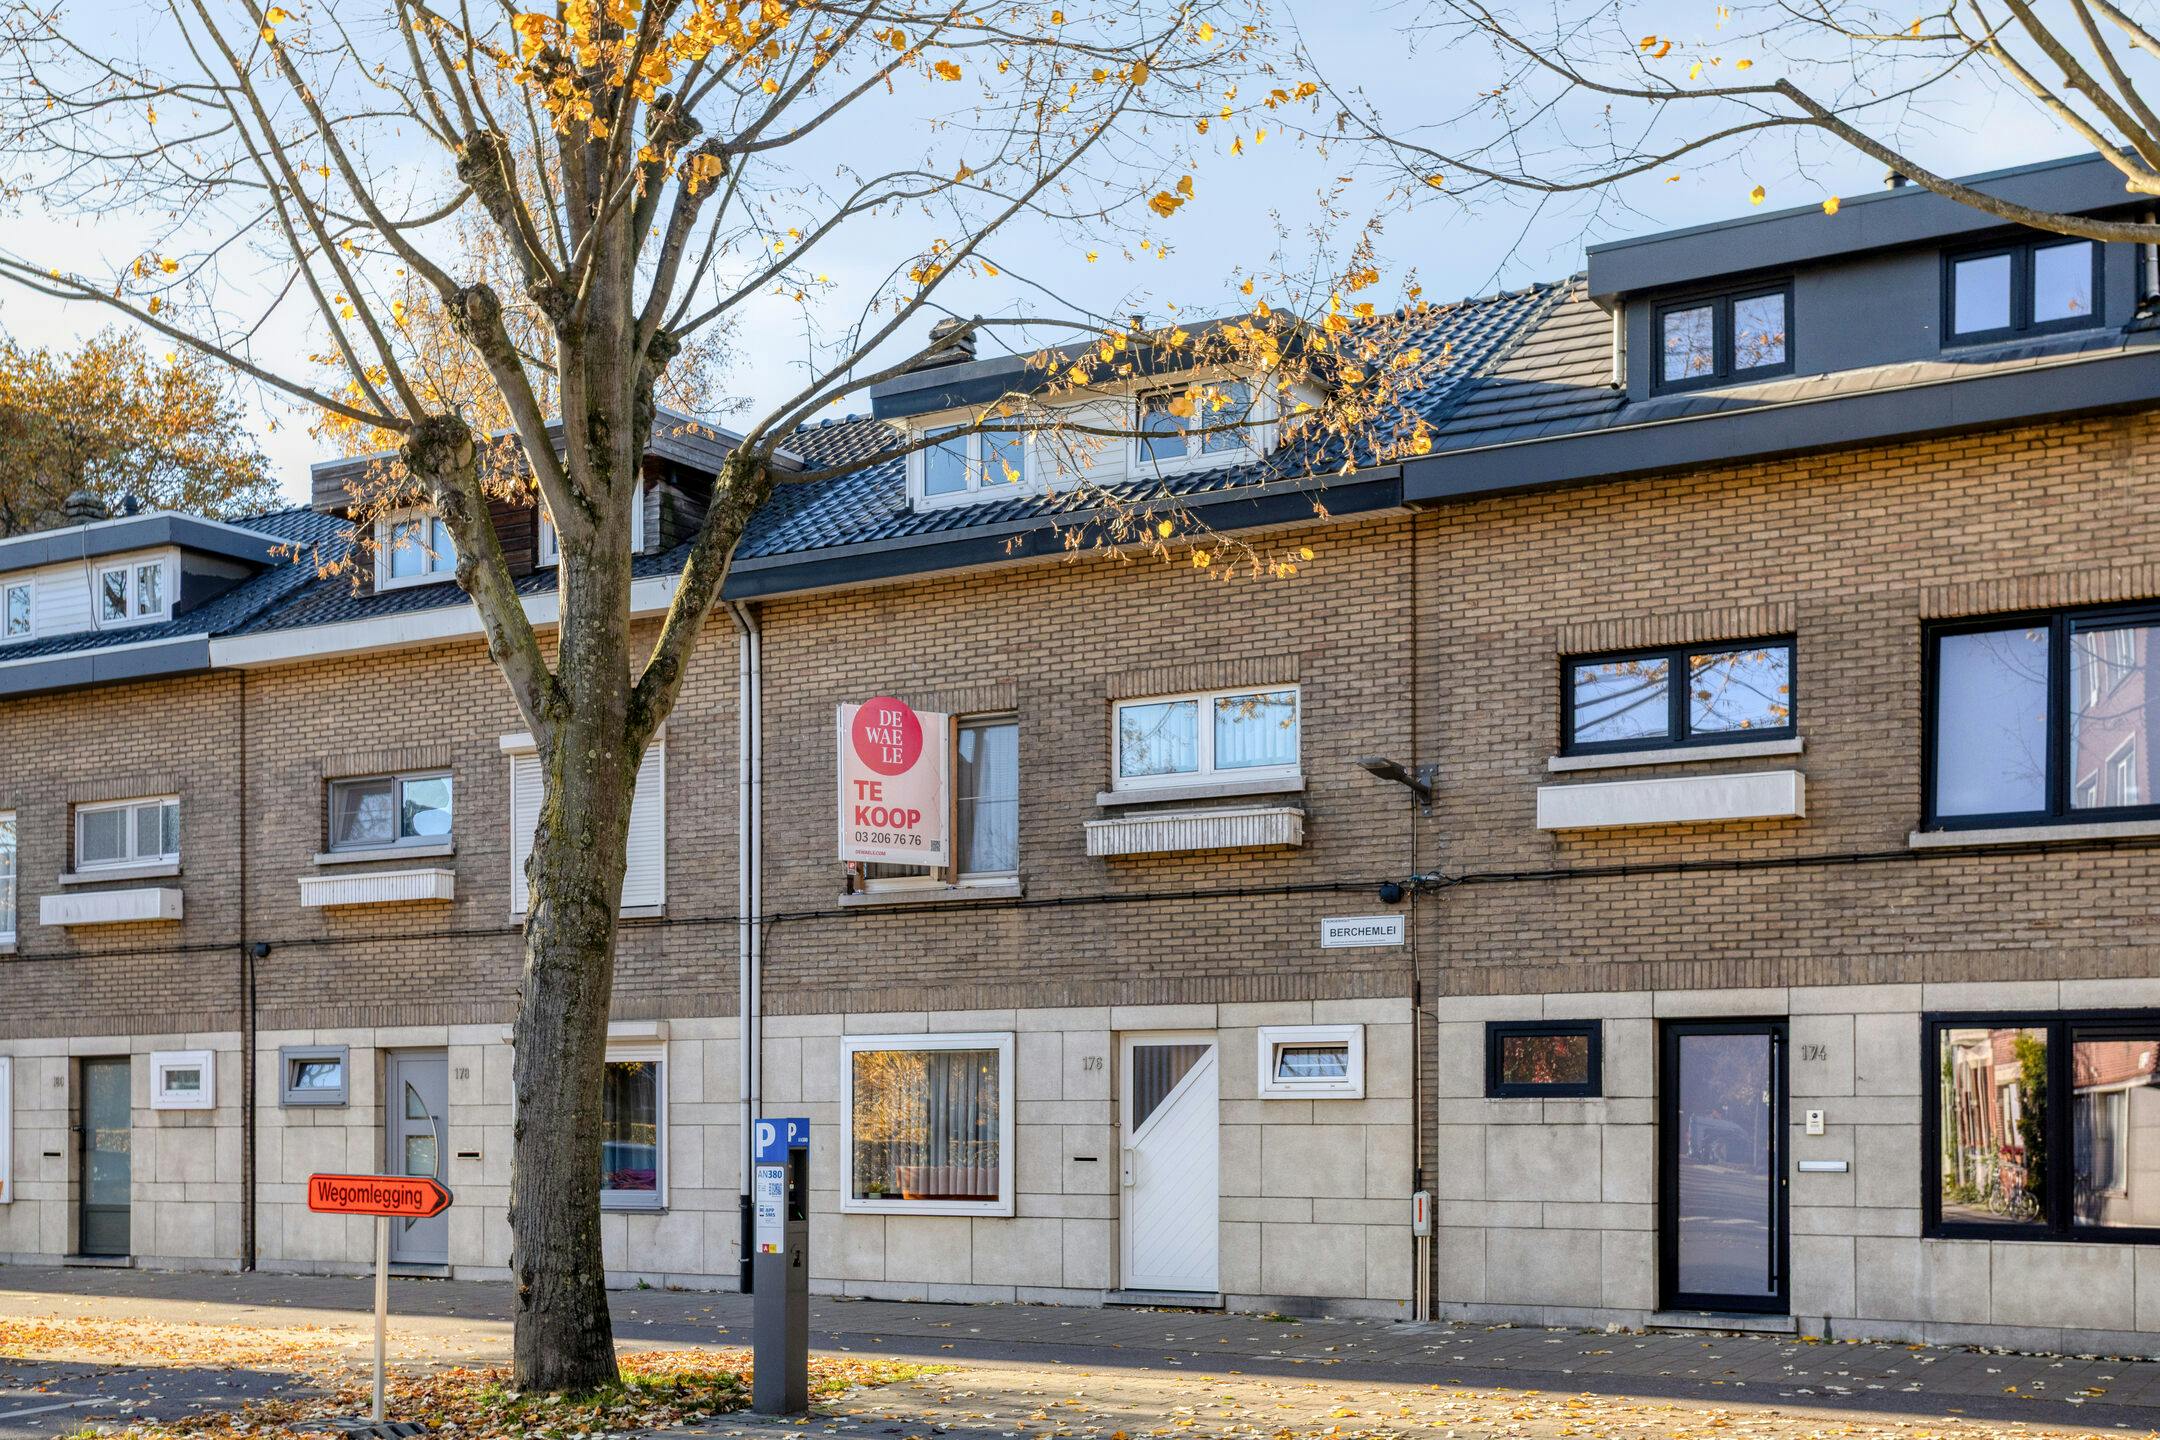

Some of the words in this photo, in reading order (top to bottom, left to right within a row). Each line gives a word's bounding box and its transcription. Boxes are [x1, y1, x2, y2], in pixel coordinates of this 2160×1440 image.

[879, 709, 903, 728] DE
[865, 727, 903, 746] WAE
[882, 746, 903, 764] LE
[853, 779, 883, 802] TE
[855, 805, 921, 830] KOOP
[855, 831, 869, 843] 03
[871, 832, 891, 844] 206
[893, 833, 906, 845] 76
[908, 834, 922, 846] 76
[1329, 925, 1396, 937] BERCHEMLEI
[1801, 1044, 1827, 1061] 174
[756, 1122, 776, 1158] P
[787, 1122, 797, 1143] P
[757, 1169, 783, 1179] AN380
[318, 1181, 422, 1209] Wegomlegging
